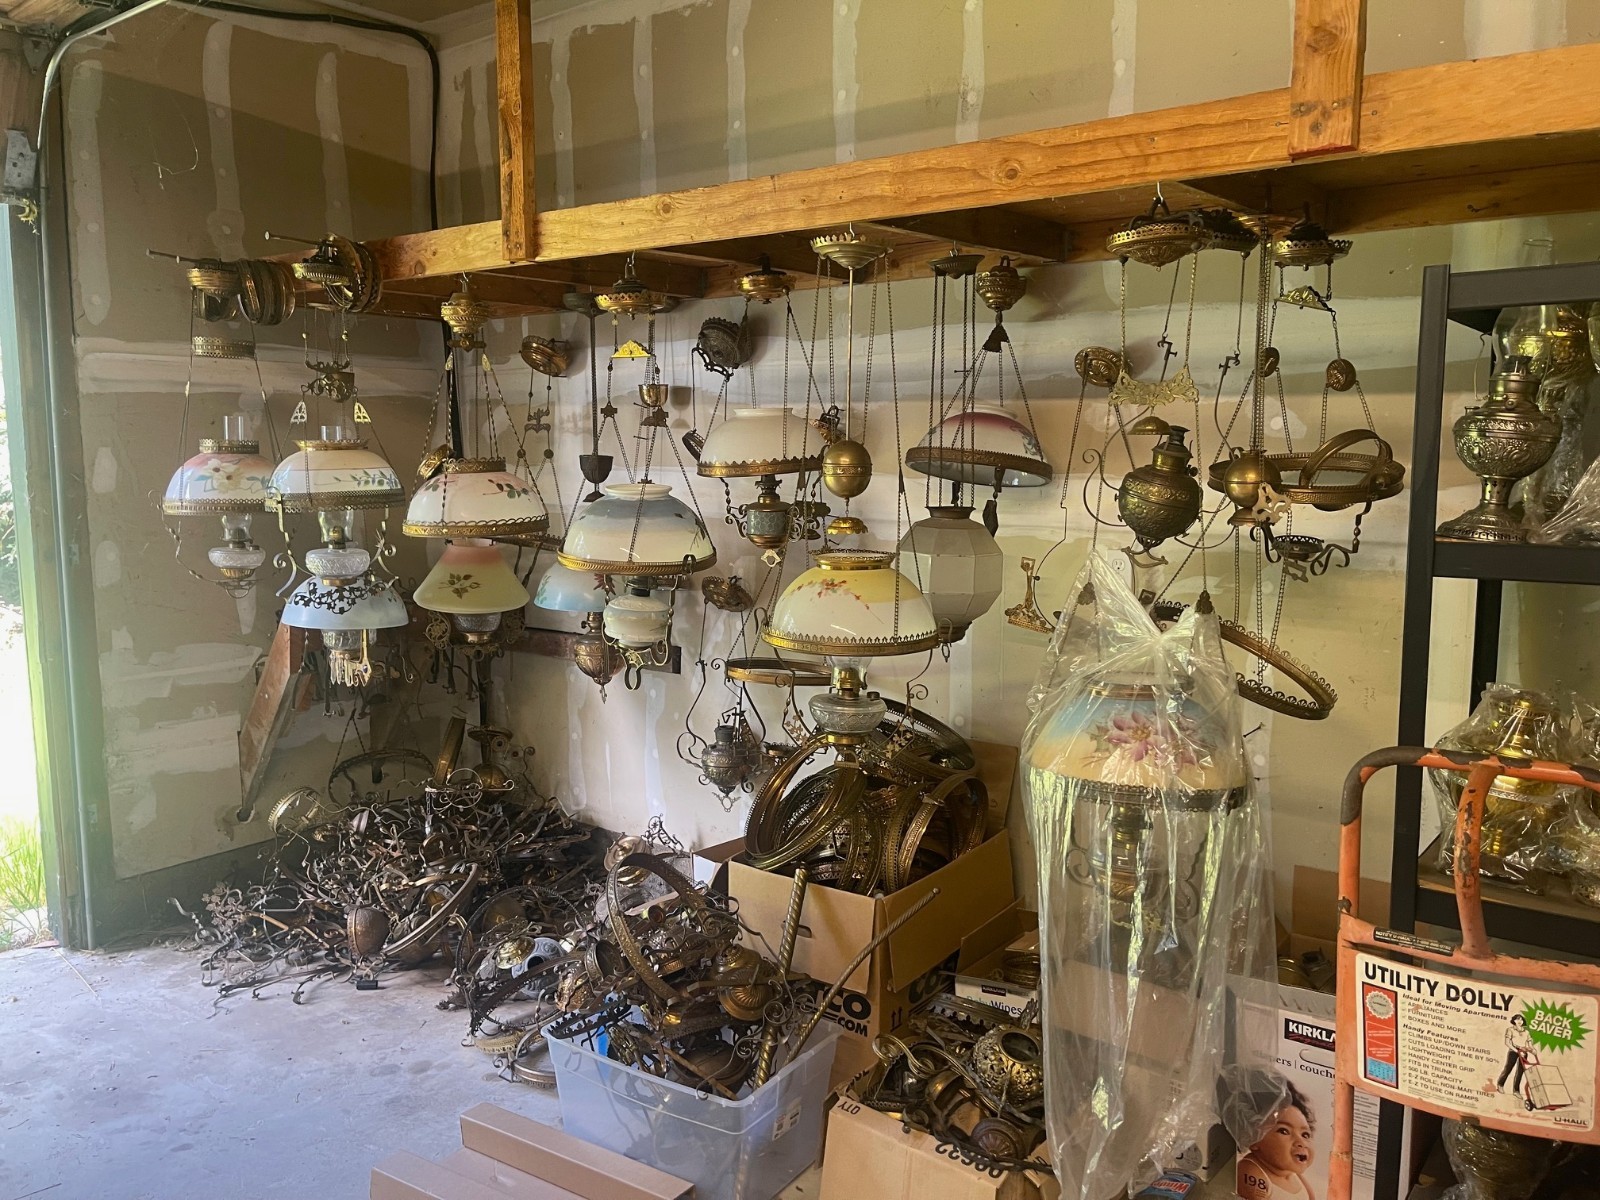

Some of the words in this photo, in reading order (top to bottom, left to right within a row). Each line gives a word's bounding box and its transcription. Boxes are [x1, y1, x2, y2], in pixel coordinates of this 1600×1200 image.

[1364, 962, 1439, 997] UTILITY
[1446, 984, 1514, 1011] DOLLY
[1402, 994, 1420, 1002] Ideal
[1435, 1002, 1460, 1012] Moving
[1463, 1009, 1507, 1020] Apartments
[1408, 1002, 1448, 1015] APIANCES
[1408, 1009, 1444, 1022] FURNITURE
[1408, 1016, 1430, 1025] BOXES
[1534, 1010, 1572, 1029] BACK
[1403, 1024, 1424, 1034] Handy
[1427, 1030, 1458, 1041] Features
[1529, 1020, 1572, 1040] SAVER
[1408, 1032, 1432, 1041] CLIMBS
[1434, 1038, 1465, 1050] UP/DOWN
[1468, 1046, 1490, 1055] STAIRS
[1427, 1043, 1455, 1054] LOADING
[1408, 1045, 1451, 1060] LIGHTWEIGHT
[1408, 1052, 1429, 1061] HANDY
[1432, 1059, 1457, 1069] CENTER
[1431, 1065, 1452, 1074] TRUNK
[1431, 1072, 1462, 1084] CAPACITY
[1456, 1093, 1479, 1102] RAMPS
[837, 1101, 860, 1114] QTY
[1244, 1174, 1266, 1189] 198
